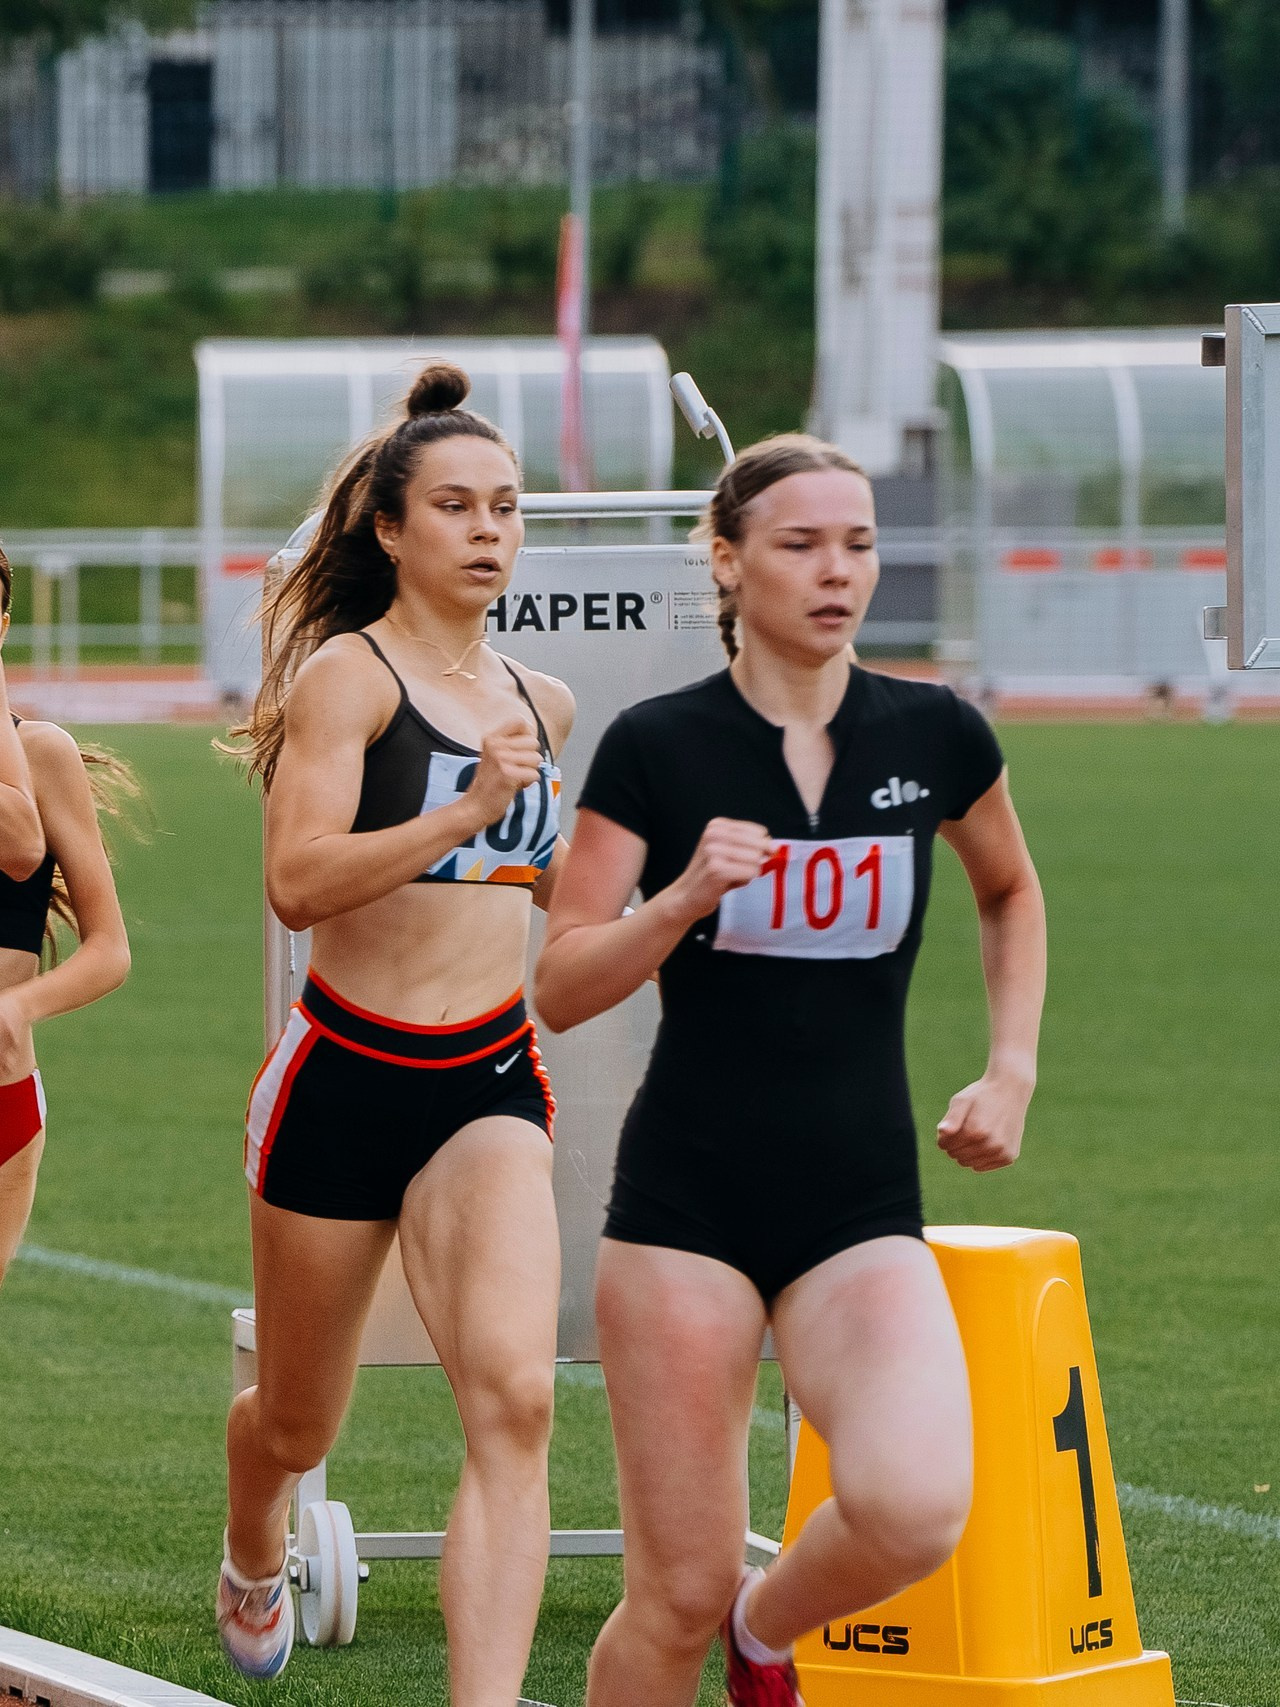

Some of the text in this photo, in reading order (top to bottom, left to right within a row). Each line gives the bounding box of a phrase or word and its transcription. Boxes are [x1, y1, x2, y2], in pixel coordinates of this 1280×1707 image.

[760, 843, 883, 930] 101
[1052, 1366, 1103, 1599] 1
[823, 1622, 910, 1656] UCS
[1070, 1618, 1113, 1655] UCS
